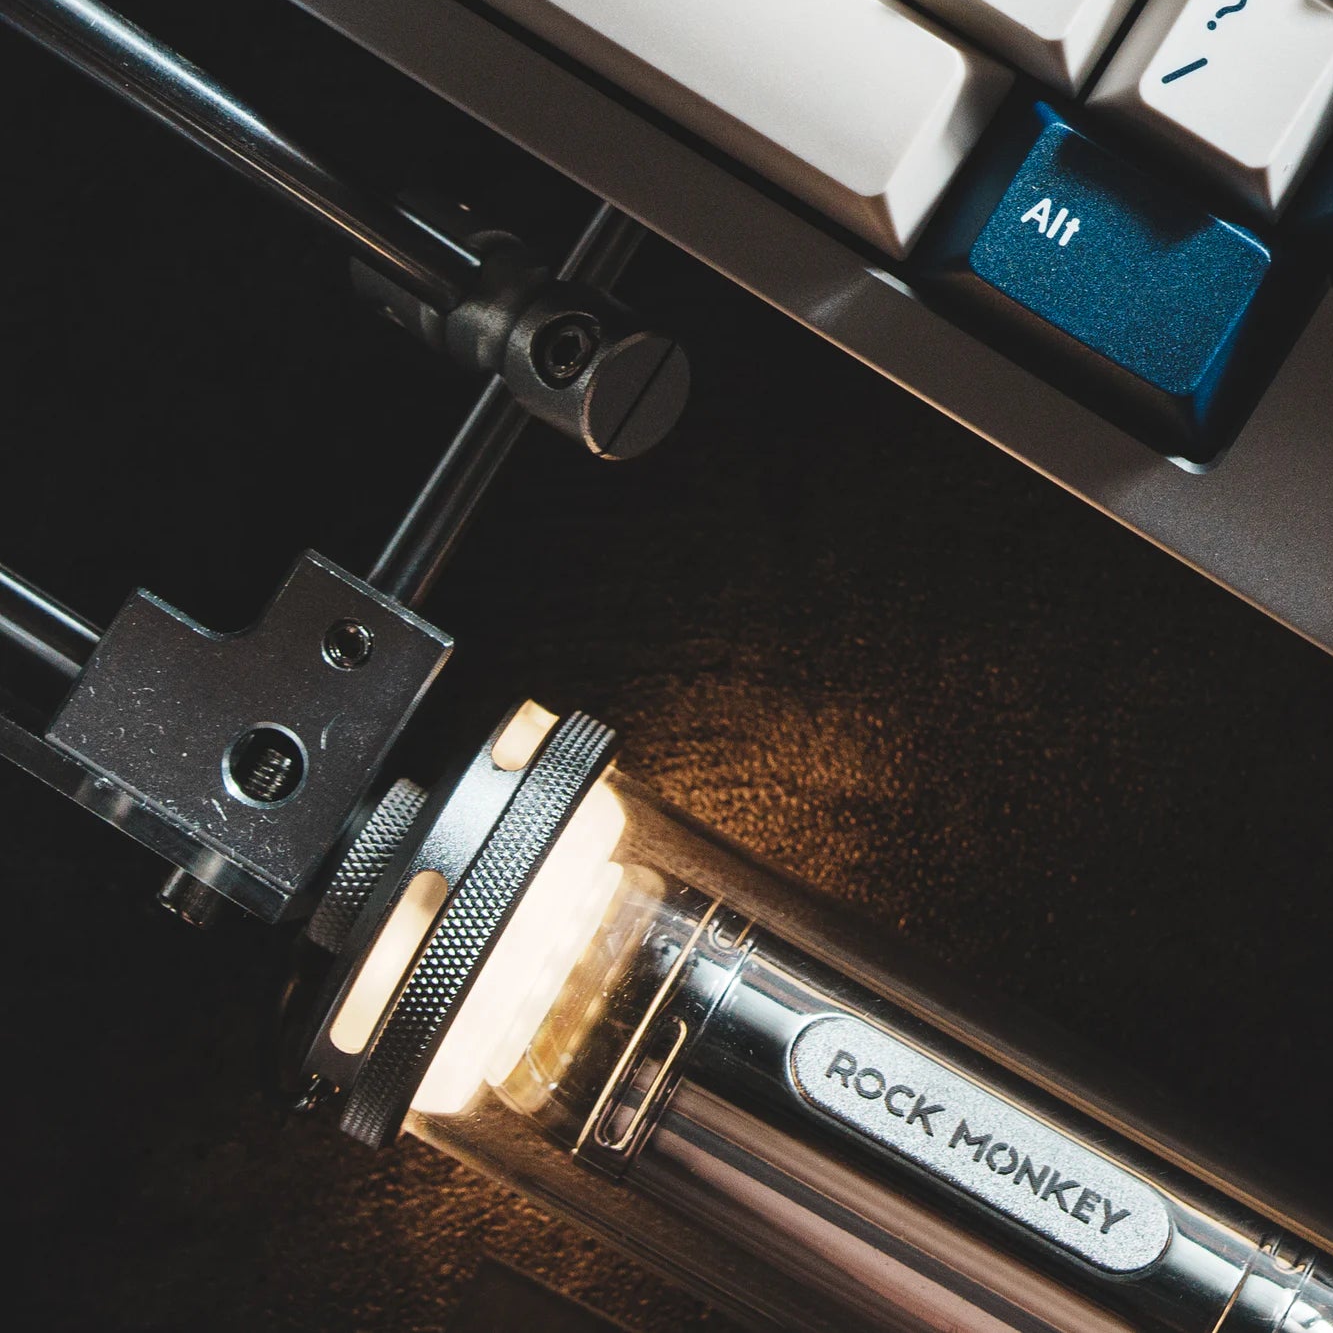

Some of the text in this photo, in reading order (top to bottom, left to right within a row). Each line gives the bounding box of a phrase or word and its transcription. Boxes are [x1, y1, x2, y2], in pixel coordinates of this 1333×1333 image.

[1020, 197, 1081, 247] Alt
[825, 1049, 1130, 1235] ROCK MONKEY
